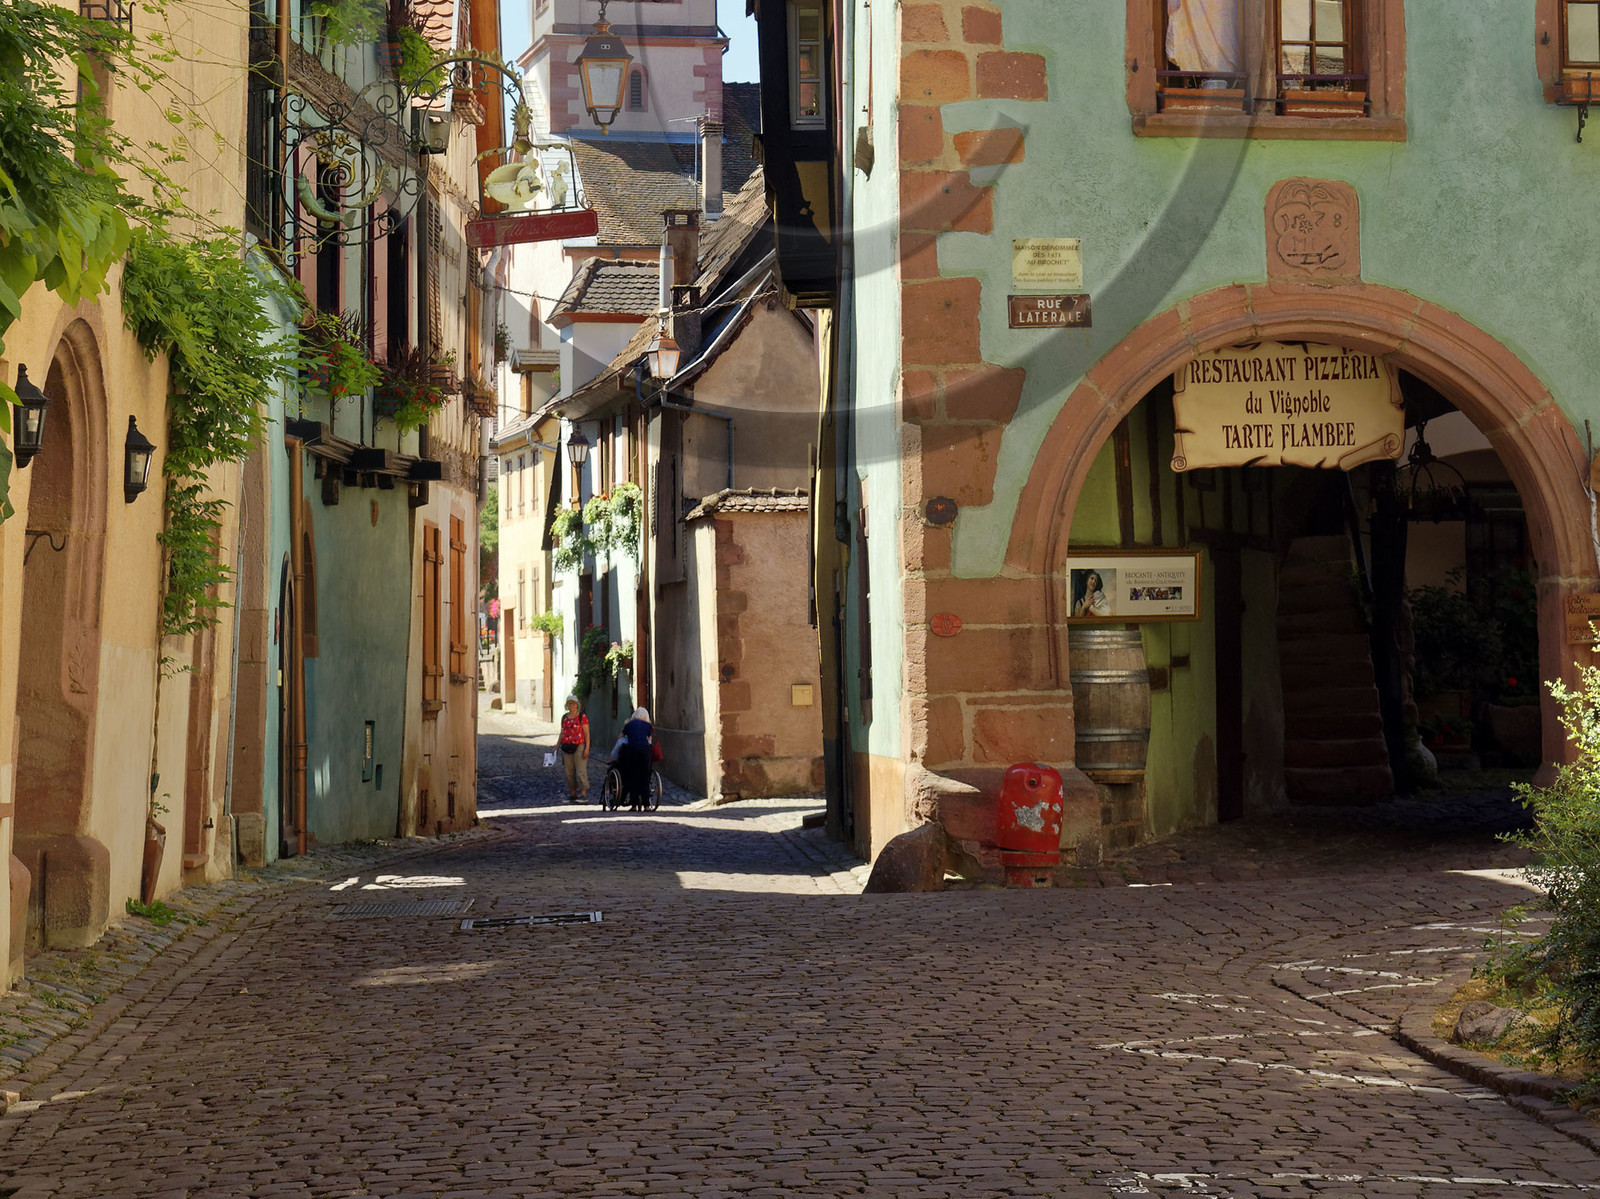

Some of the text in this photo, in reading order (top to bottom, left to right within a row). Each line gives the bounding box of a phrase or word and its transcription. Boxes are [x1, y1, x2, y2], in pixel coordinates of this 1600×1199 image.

[1019, 311, 1082, 323] LATERALE
[1037, 299, 1062, 309] RUE
[1189, 356, 1297, 384] RESTAURANT
[1245, 389, 1332, 419] du Vignoble
[1222, 422, 1356, 452] TARTE FLAMBEE
